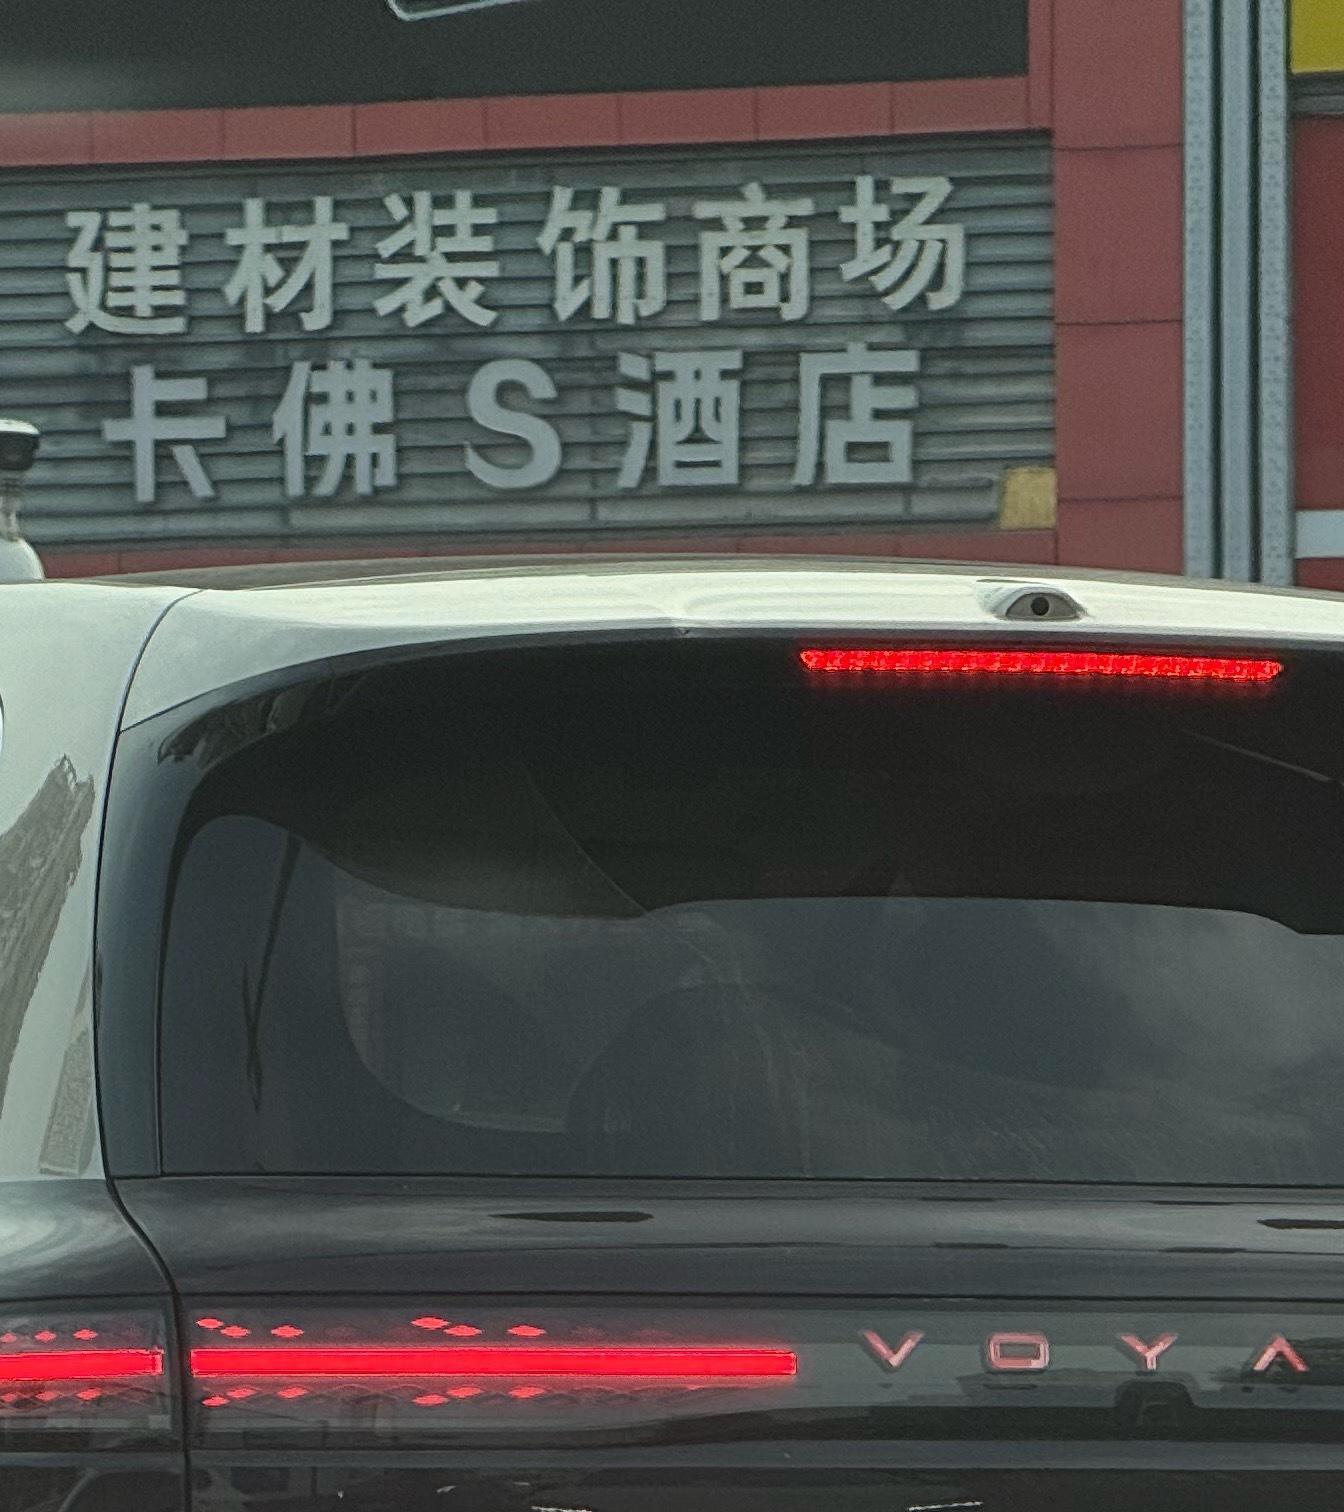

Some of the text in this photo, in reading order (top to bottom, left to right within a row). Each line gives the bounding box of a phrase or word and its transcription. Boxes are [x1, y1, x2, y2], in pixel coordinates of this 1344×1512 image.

[64, 174, 967, 338] 建材装饰商场
[103, 341, 922, 503] 卡佛S酒店
